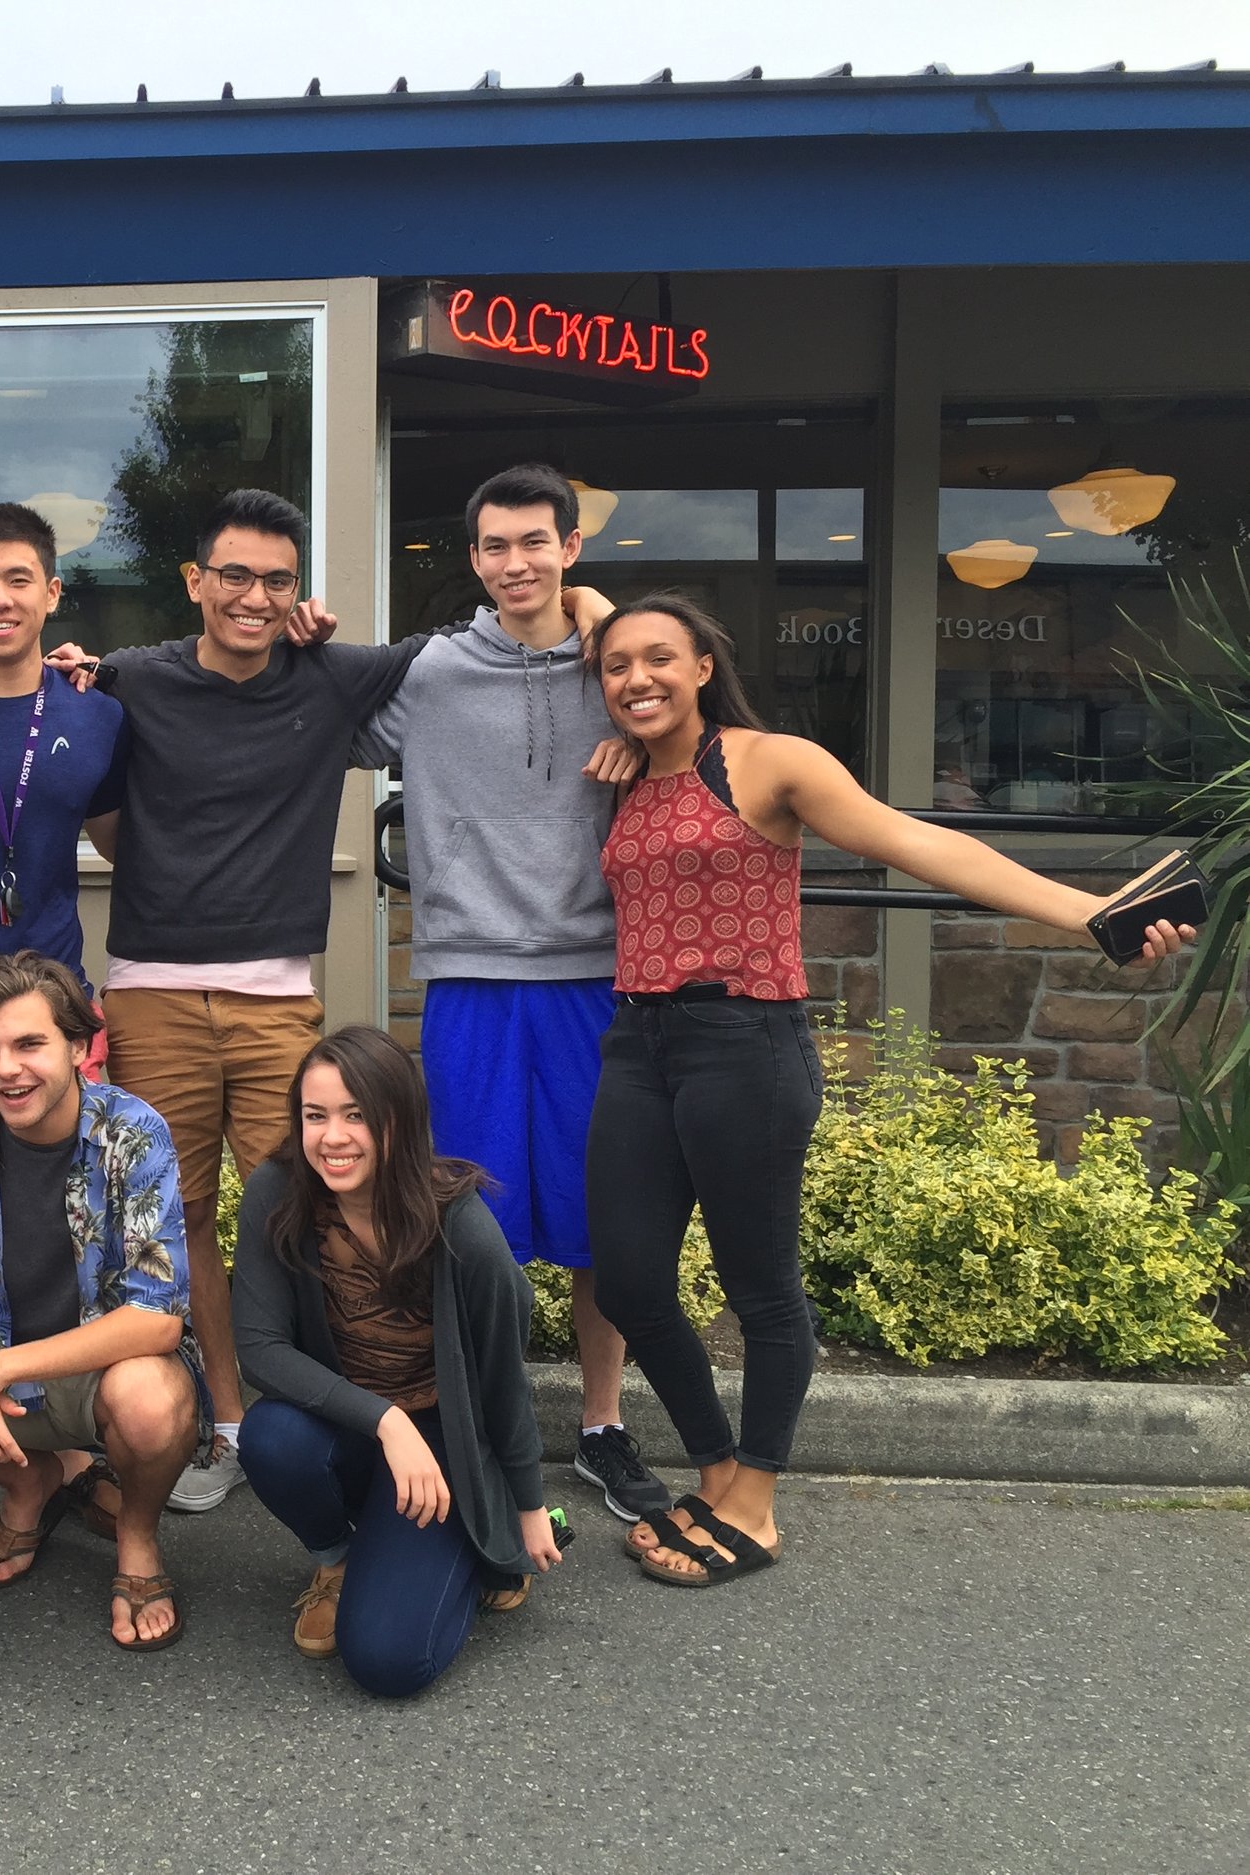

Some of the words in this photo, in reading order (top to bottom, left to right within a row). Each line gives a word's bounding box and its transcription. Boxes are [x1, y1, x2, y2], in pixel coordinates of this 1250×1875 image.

[449, 289, 710, 379] COCKTAILS
[19, 749, 35, 786] FOSTER
[34, 686, 45, 717] FOSTE
